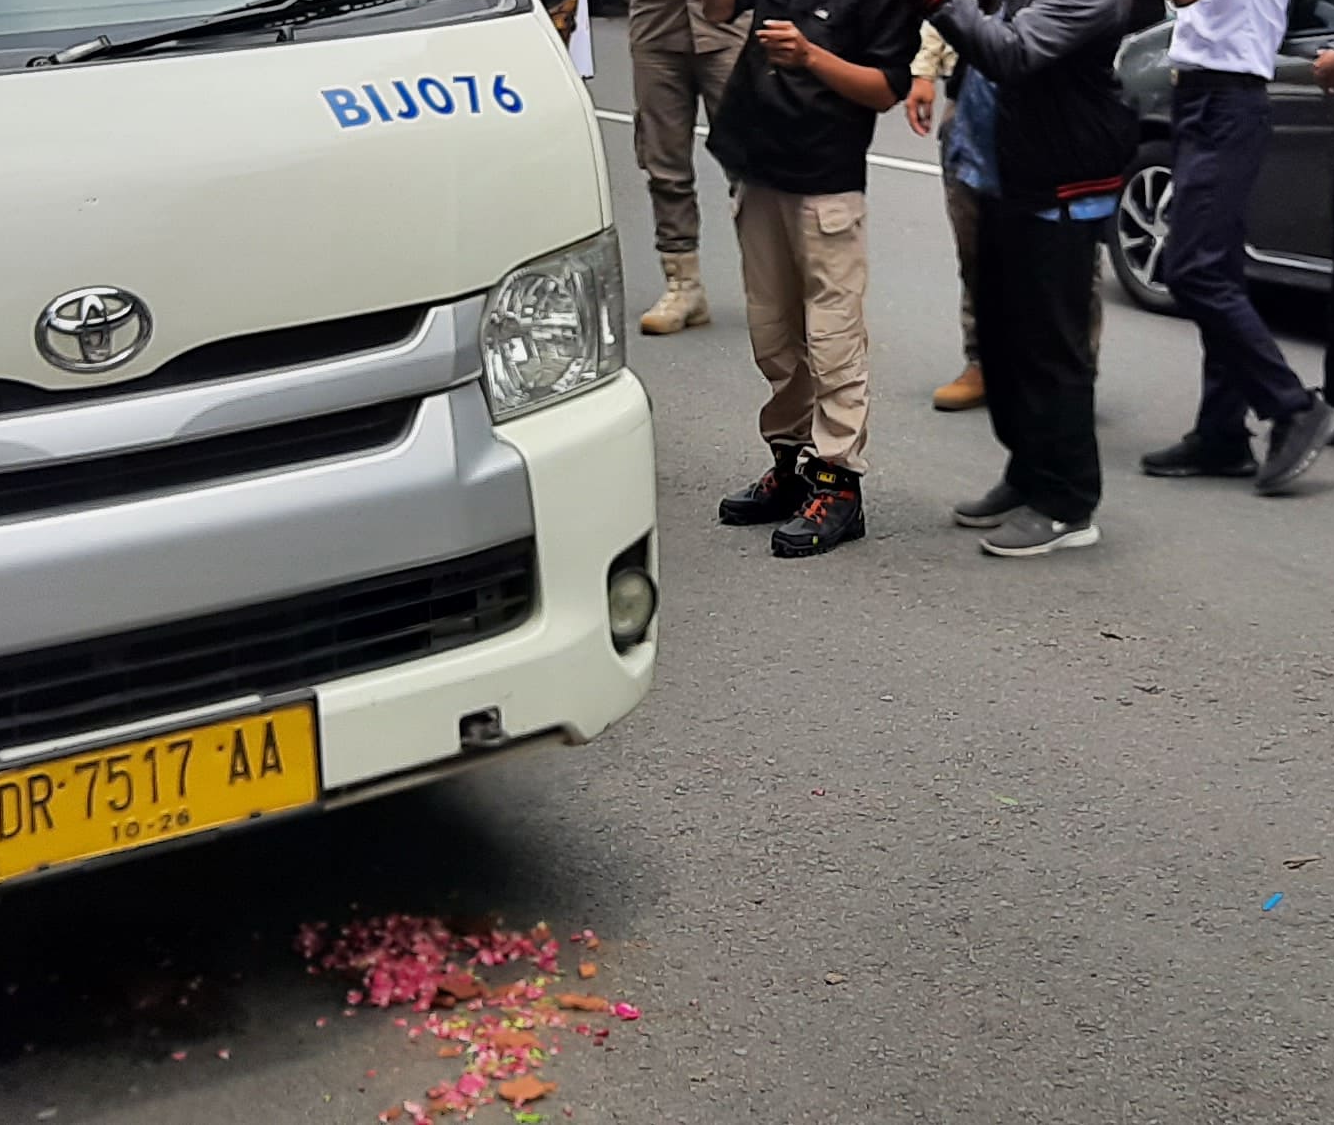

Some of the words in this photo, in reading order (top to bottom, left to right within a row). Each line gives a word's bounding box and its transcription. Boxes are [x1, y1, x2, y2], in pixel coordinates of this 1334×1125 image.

[75, 739, 193, 819] 7517
[228, 721, 283, 784] AA
[112, 809, 190, 842] 10-26
